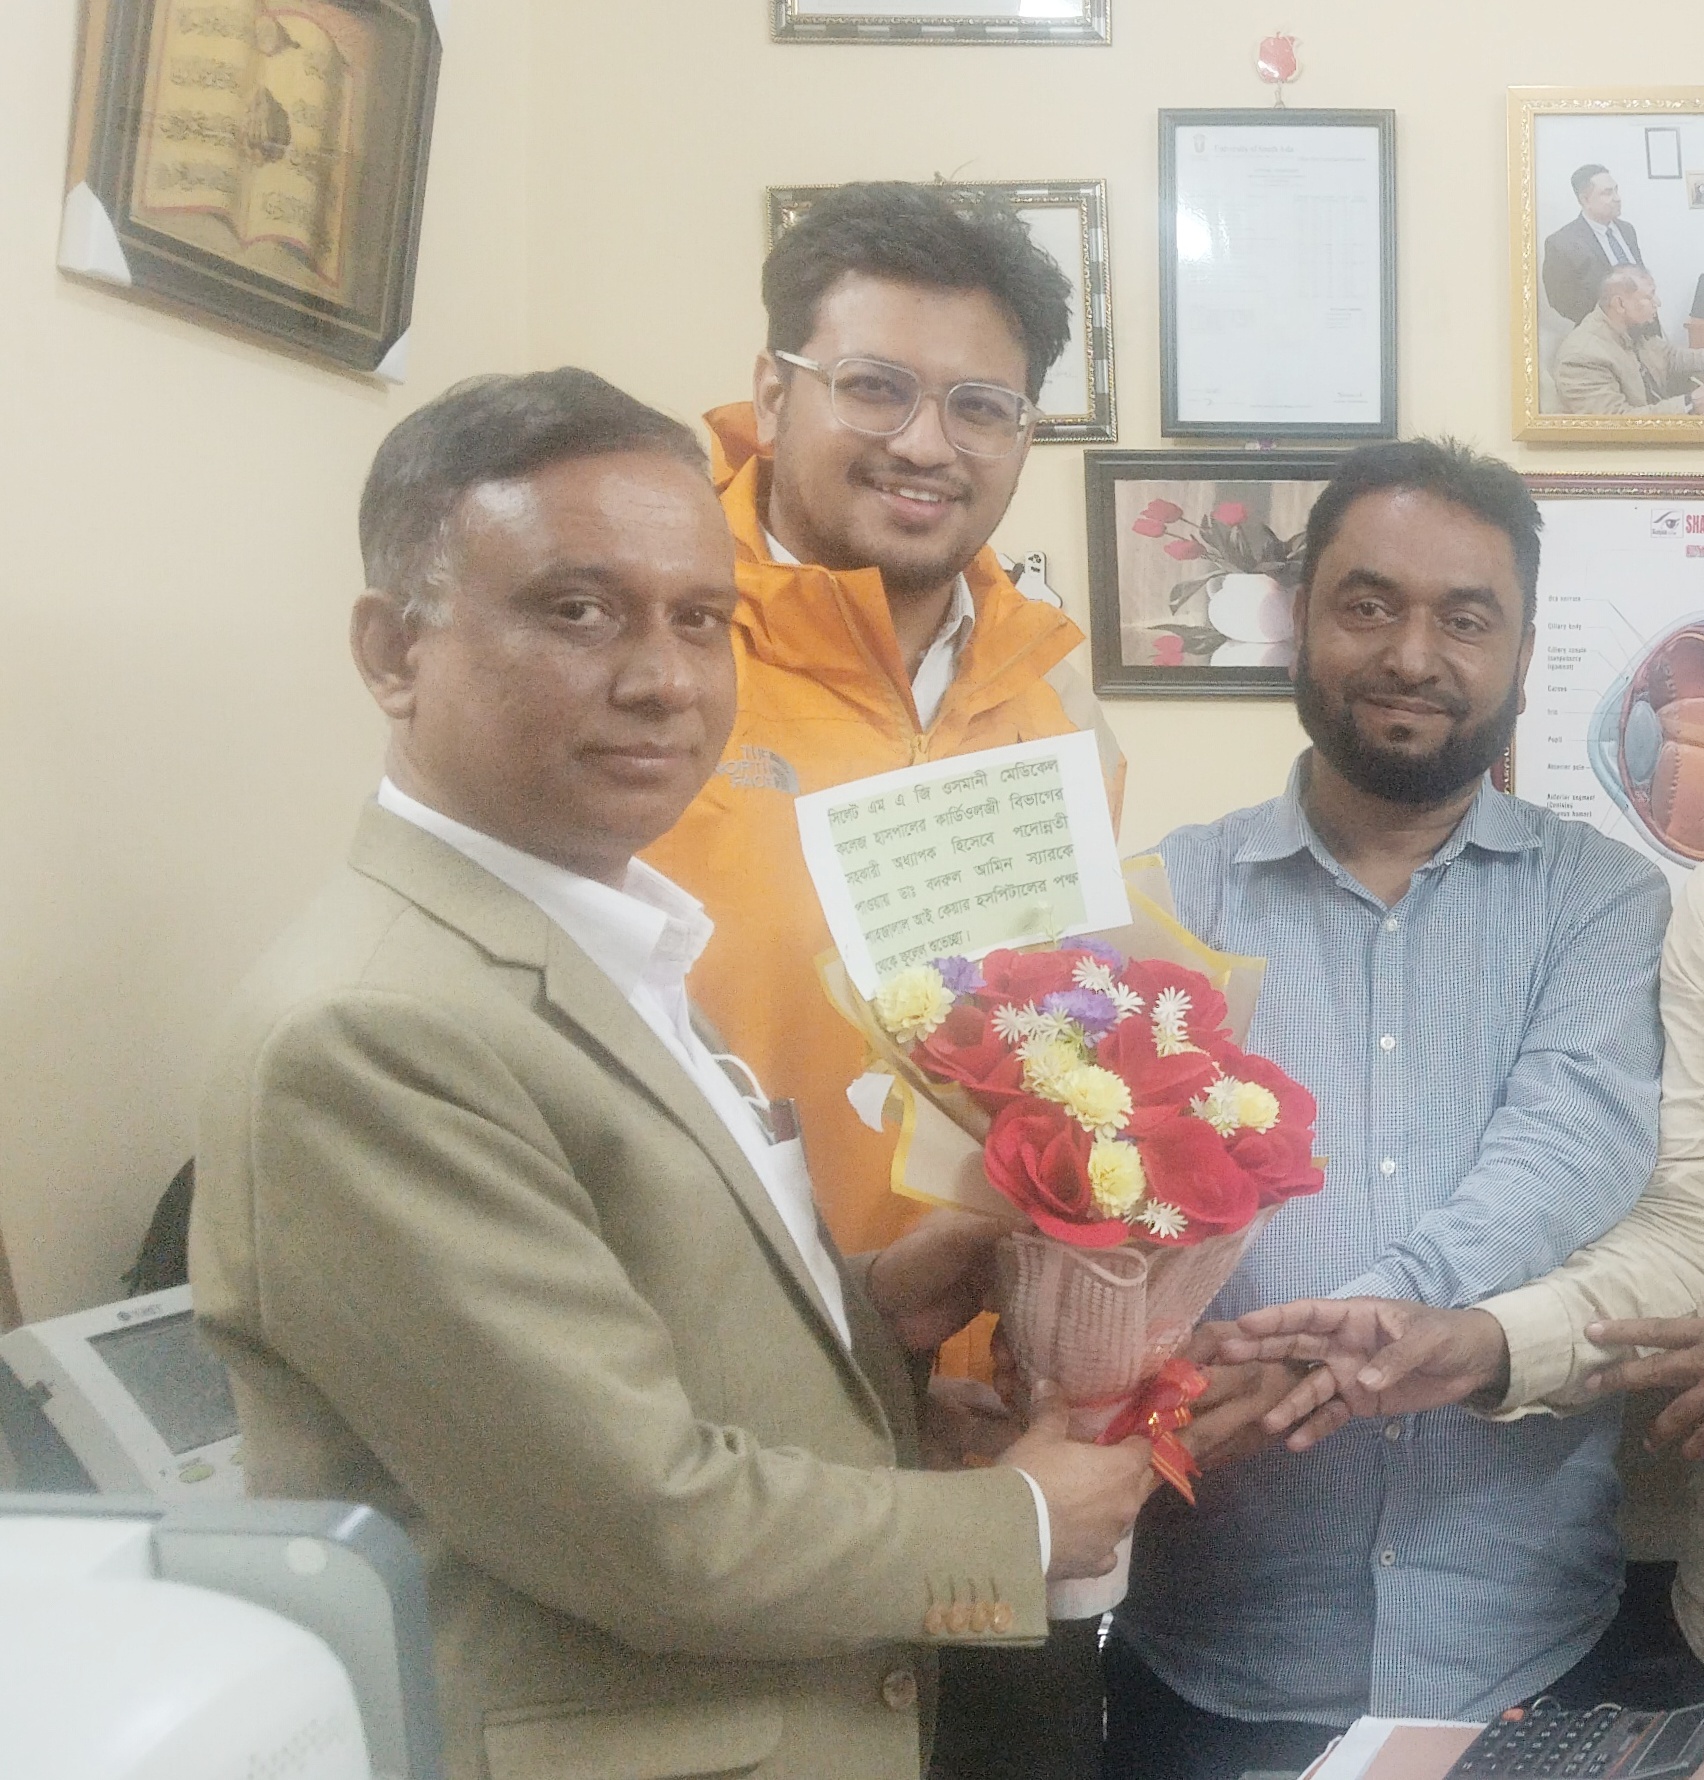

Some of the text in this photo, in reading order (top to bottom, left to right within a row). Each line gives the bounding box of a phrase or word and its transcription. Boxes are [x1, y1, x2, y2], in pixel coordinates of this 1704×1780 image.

[827, 803, 860, 827] সিলেট
[894, 794, 906, 807] এ
[913, 784, 931, 804] জি
[941, 769, 989, 795] ওসমানী
[1000, 758, 1059, 784] মেডিকেল
[834, 835, 868, 856] কলেজ
[1009, 787, 1064, 811] বিভাগের
[844, 860, 881, 887] সহকারী
[892, 846, 938, 871] অধ্যাপক
[950, 831, 996, 854] হিসেবে
[925, 870, 962, 892] বদরুল
[973, 856, 1014, 878] আমিন
[1026, 844, 1074, 867] স্যারকে
[912, 907, 933, 927] আই
[974, 879, 1048, 908] হসপিটালের
[1053, 871, 1079, 890] পক্ষ
